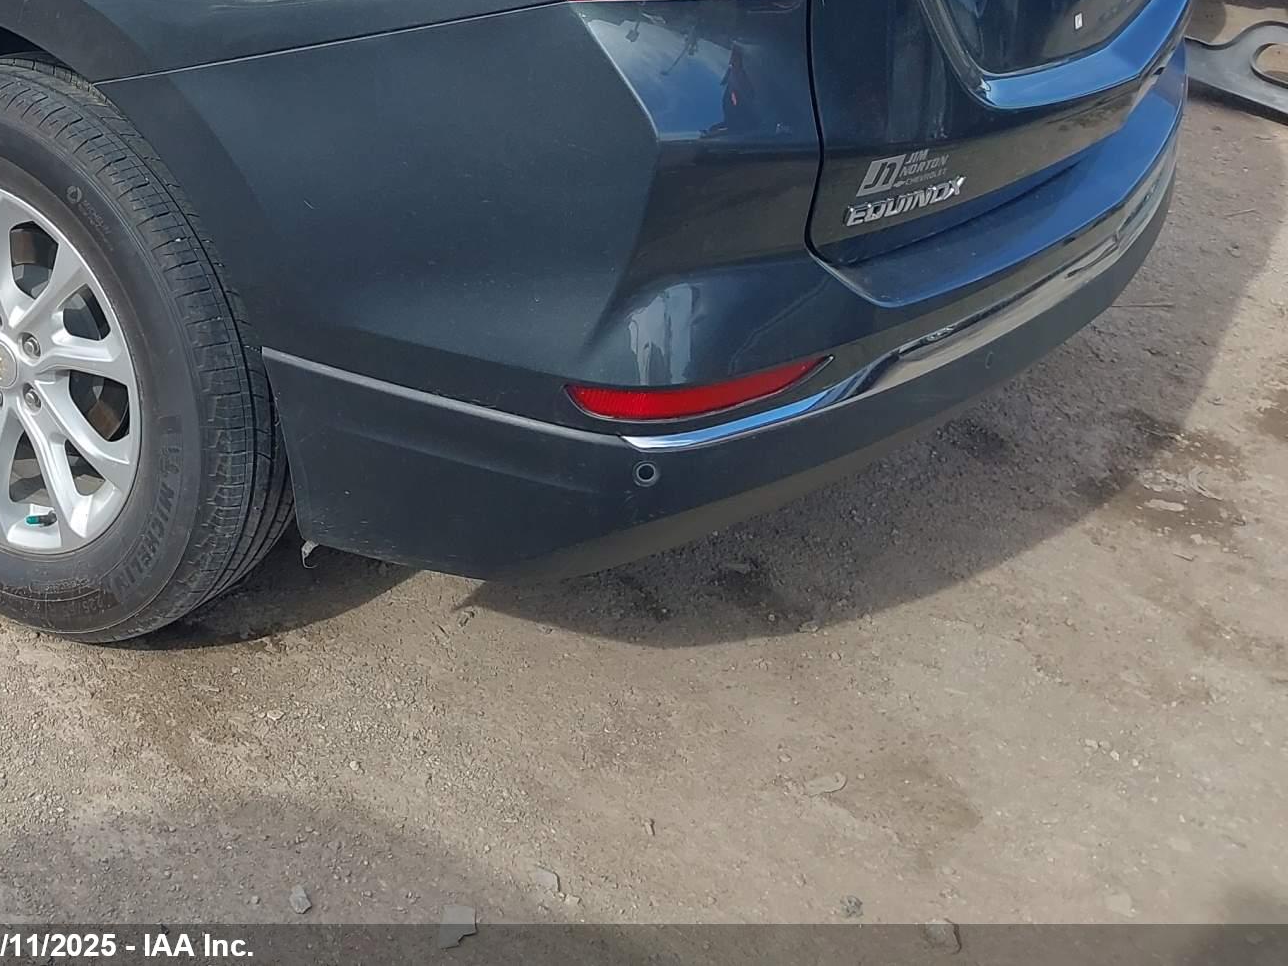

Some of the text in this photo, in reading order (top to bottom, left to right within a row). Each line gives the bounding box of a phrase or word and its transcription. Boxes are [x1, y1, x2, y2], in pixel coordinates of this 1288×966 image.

[899, 154, 950, 177] NORTON
[904, 148, 930, 165] JIM
[844, 175, 966, 227] EQUINOX
[113, 481, 176, 593] MICHELIN
